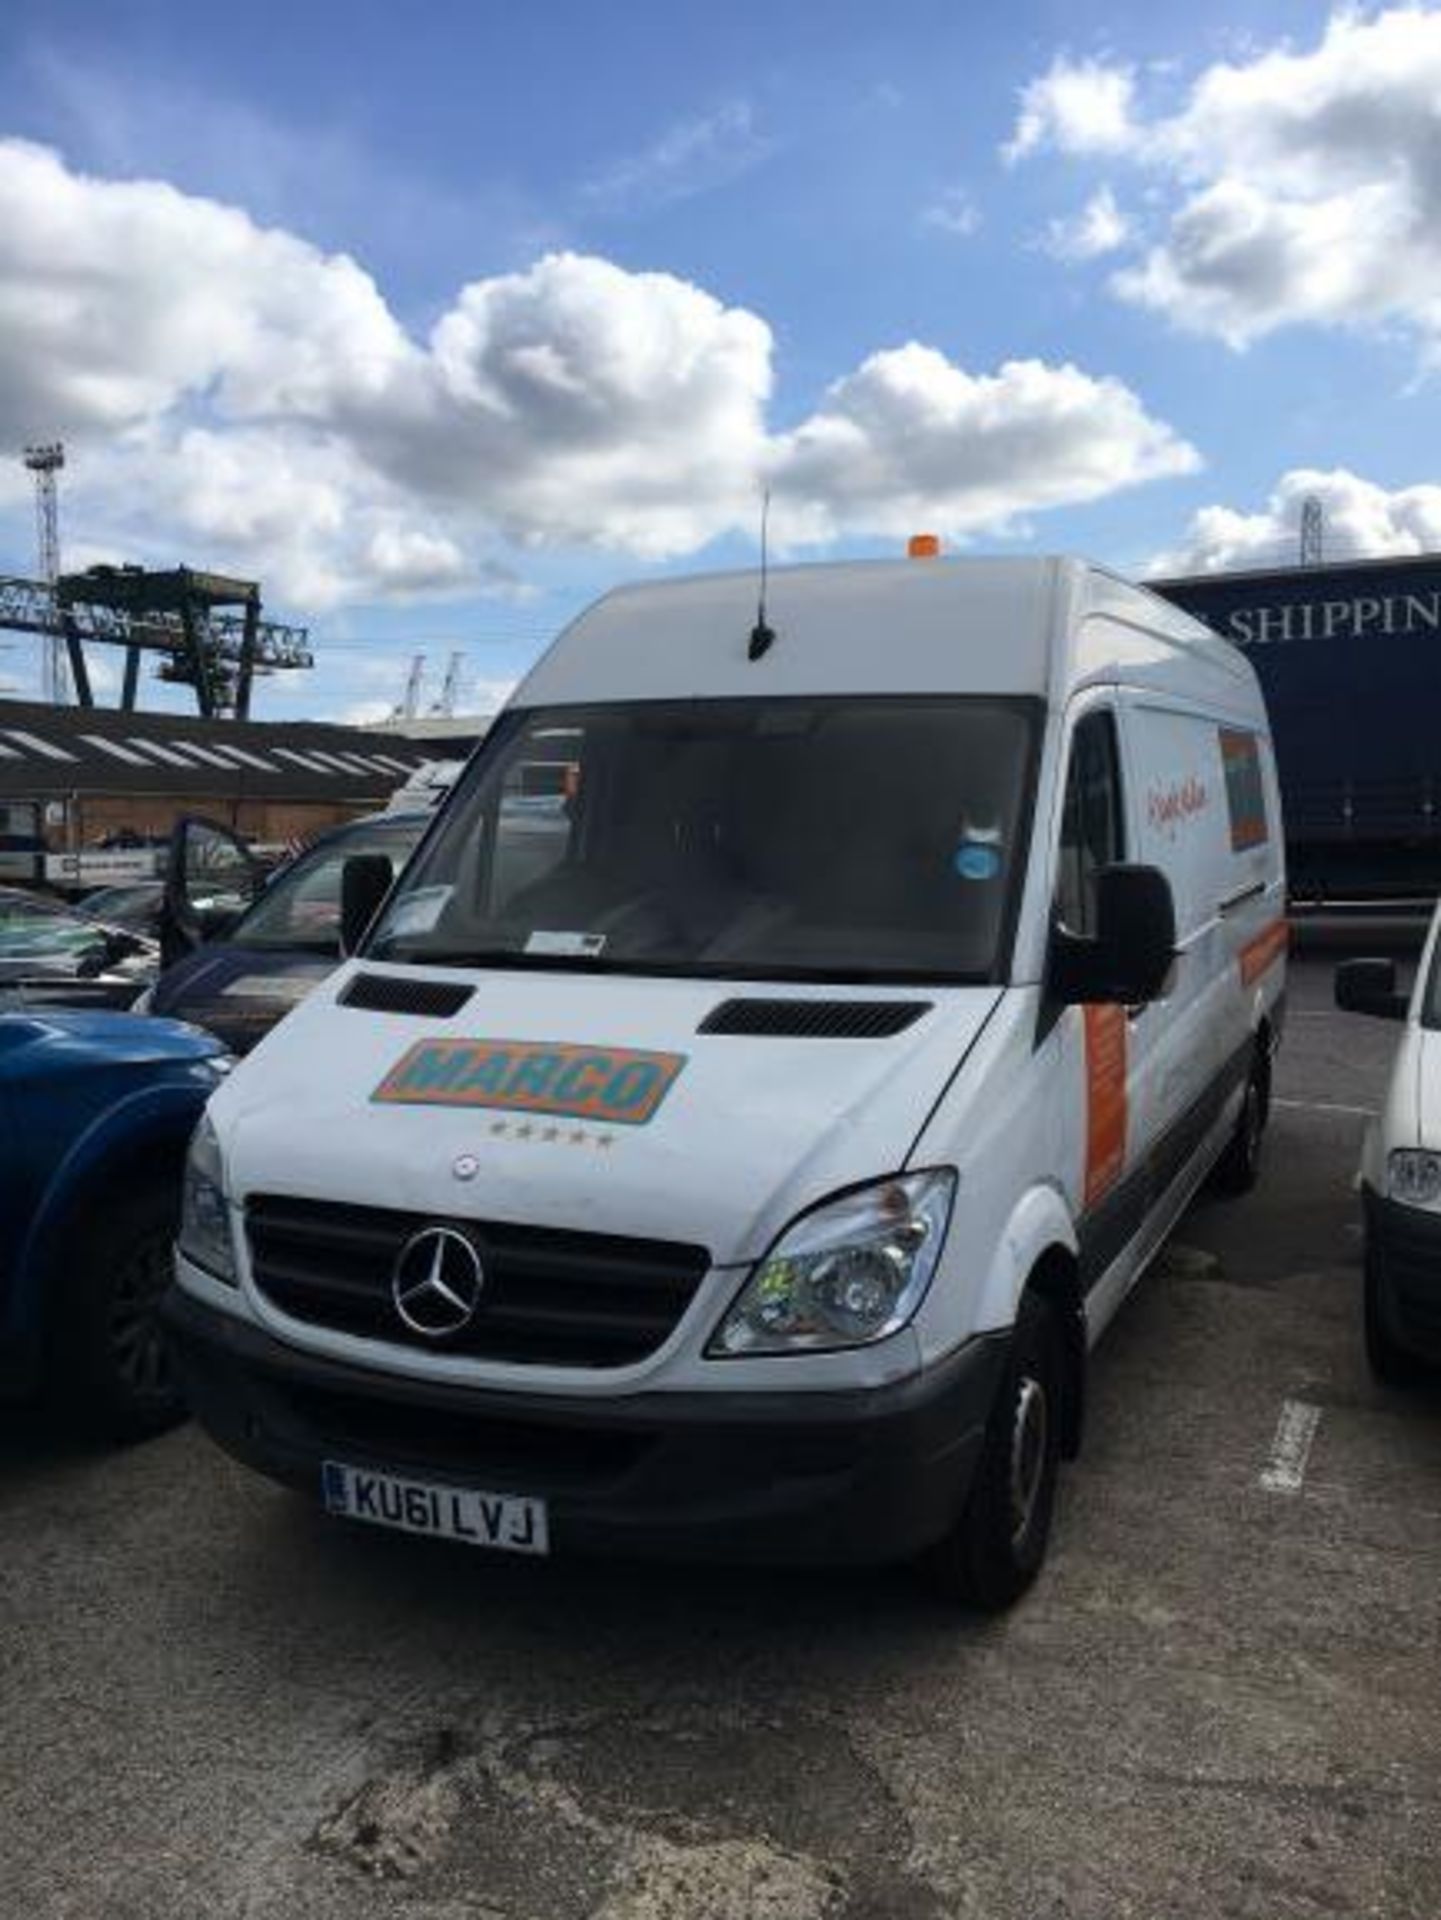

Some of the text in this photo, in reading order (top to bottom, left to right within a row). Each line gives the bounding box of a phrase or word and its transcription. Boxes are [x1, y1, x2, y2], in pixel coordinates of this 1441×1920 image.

[1229, 592, 1441, 645] SHIPPIN
[401, 1048, 661, 1109] MARCO
[354, 1473, 534, 1546] KU61 LVJ
